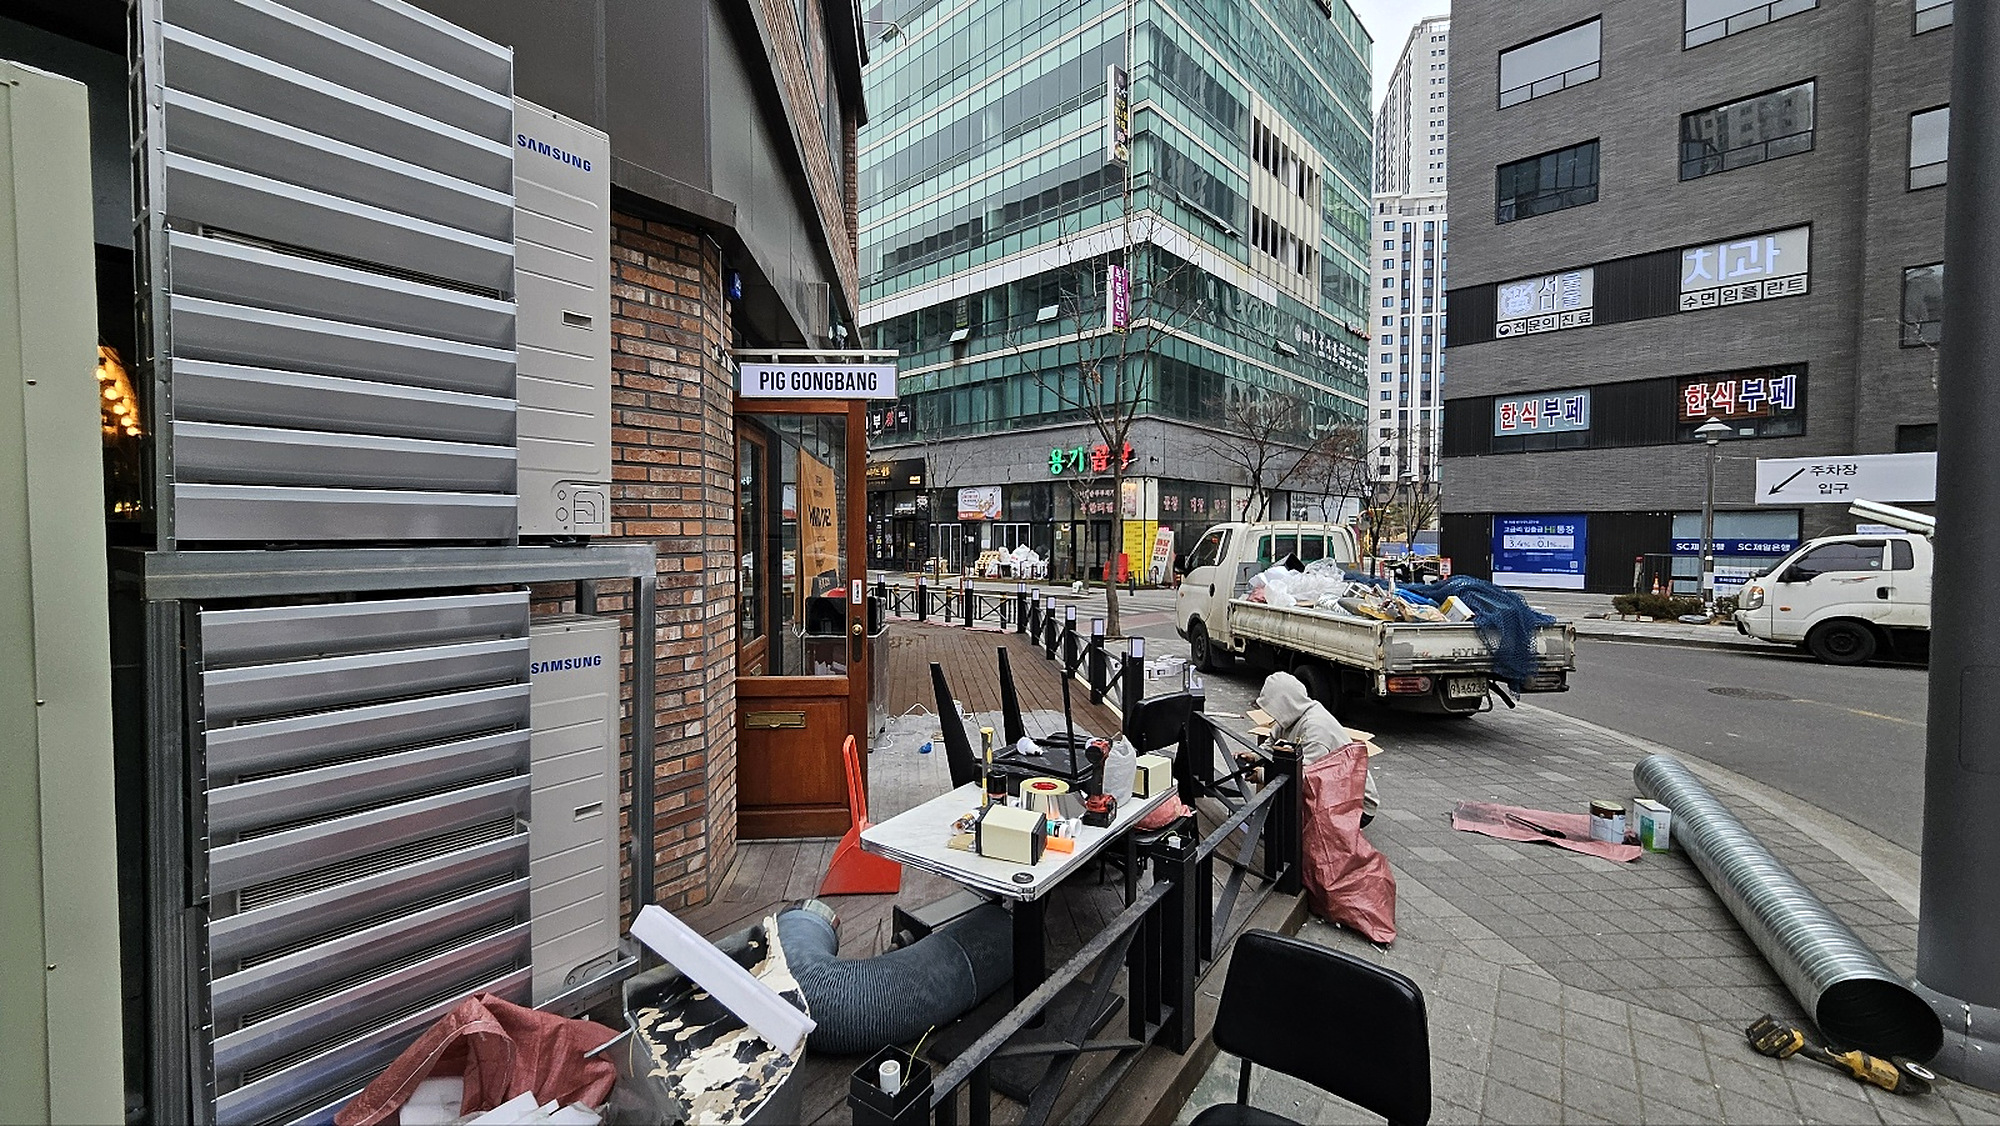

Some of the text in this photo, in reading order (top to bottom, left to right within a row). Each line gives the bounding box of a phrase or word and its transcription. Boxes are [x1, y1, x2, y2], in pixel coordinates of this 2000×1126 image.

[517, 134, 591, 172] SAMSUNG
[1684, 237, 1781, 285] 치과
[1513, 311, 1591, 334] 전문의 진료
[759, 371, 878, 391] PIG GONGBANG
[1683, 374, 1797, 416] 한식부페
[1499, 394, 1585, 430] 한식부페
[1047, 445, 1085, 475] 용기
[1809, 464, 1858, 476] 주차장
[1818, 482, 1849, 494] 입구
[1737, 543, 1791, 552] SC제일은행
[530, 655, 602, 674] SAMSUNG
